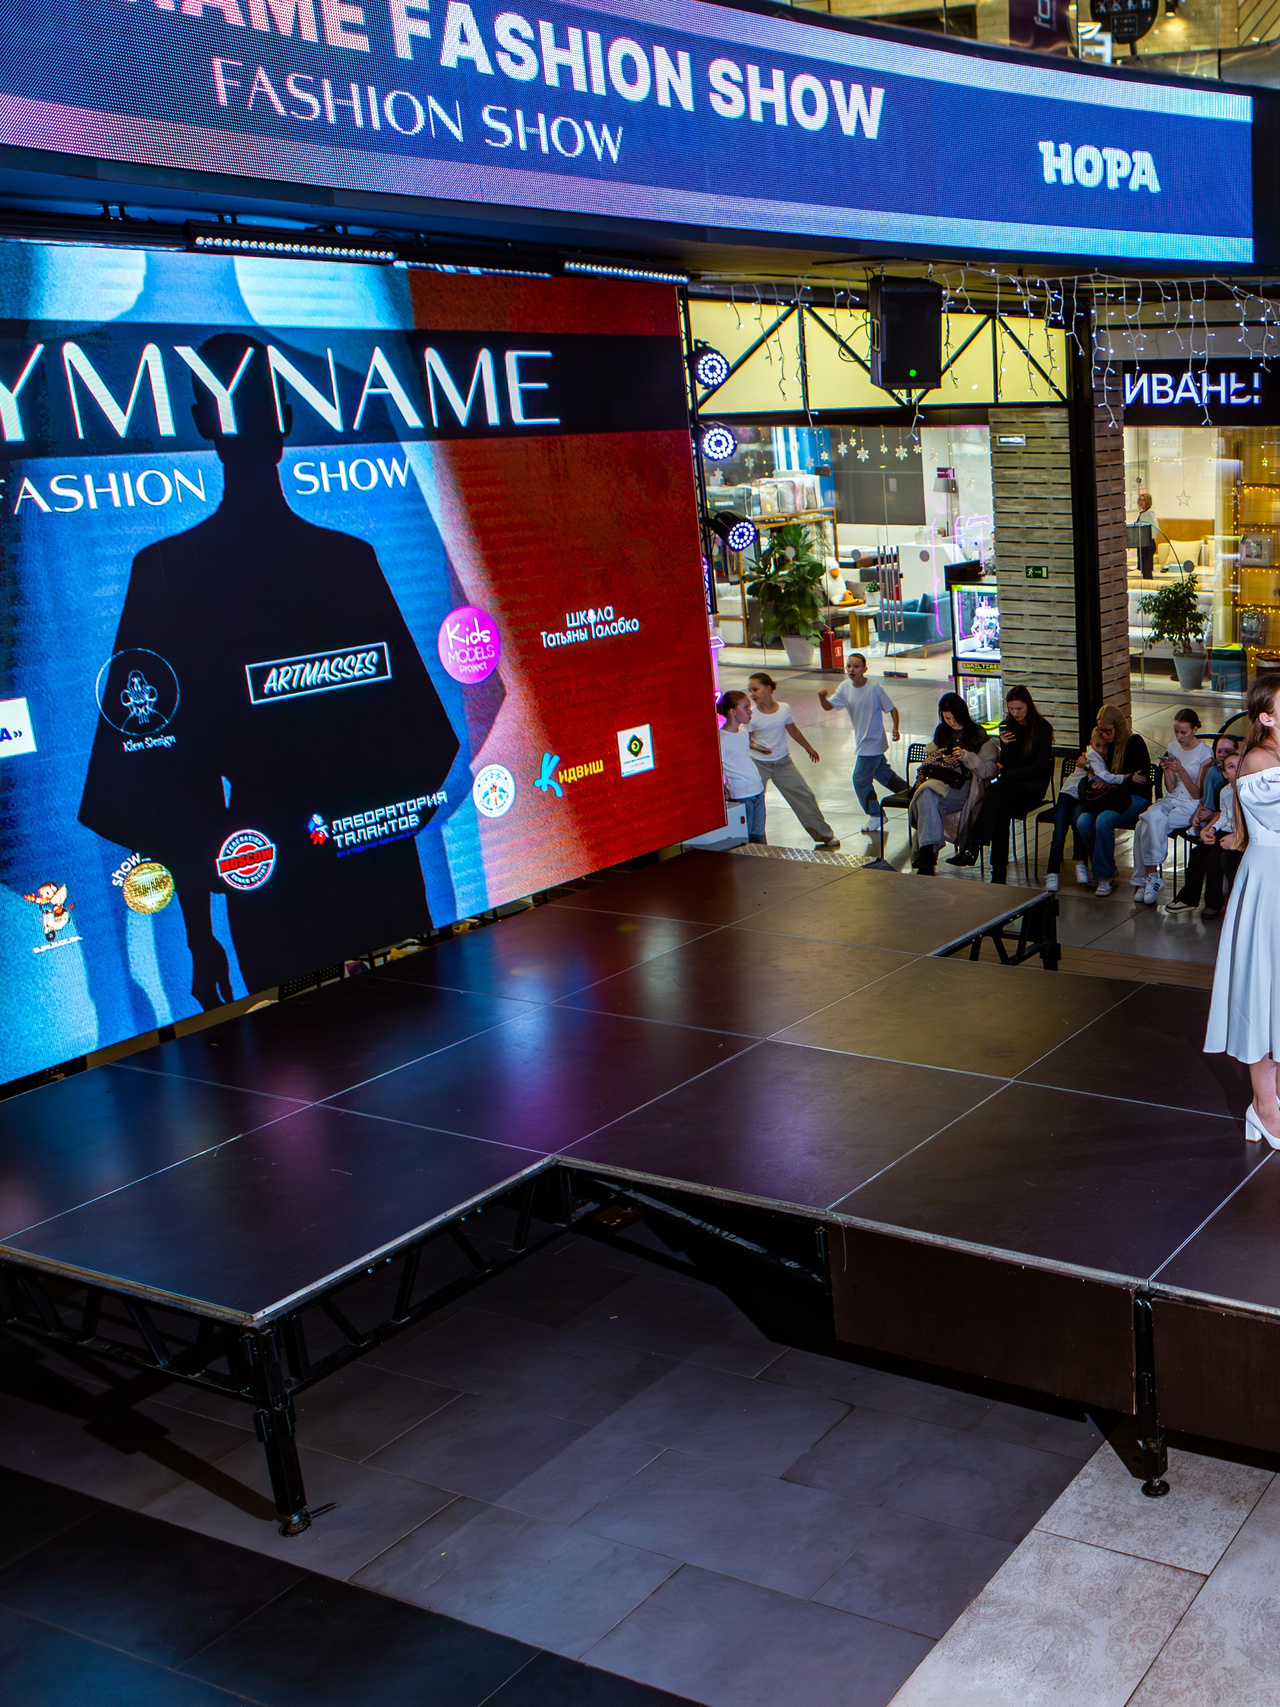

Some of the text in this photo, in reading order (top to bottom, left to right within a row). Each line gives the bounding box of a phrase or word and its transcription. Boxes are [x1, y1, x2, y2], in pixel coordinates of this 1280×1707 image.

[392, 2, 695, 111] FASHION
[709, 58, 885, 139] SHOW
[212, 57, 624, 164] FASHION SHOW
[0, 457, 410, 515] ASHION SHOW
[445, 617, 492, 650] Kids
[539, 627, 589, 649] Татьяны
[262, 650, 380, 695] ARTMASSES
[447, 644, 496, 665] MODELS
[331, 790, 449, 835] ЛАБОРАТОРИЯ
[332, 813, 421, 849] ТАЛАНТОВ
[219, 847, 273, 873] MOSCOW
